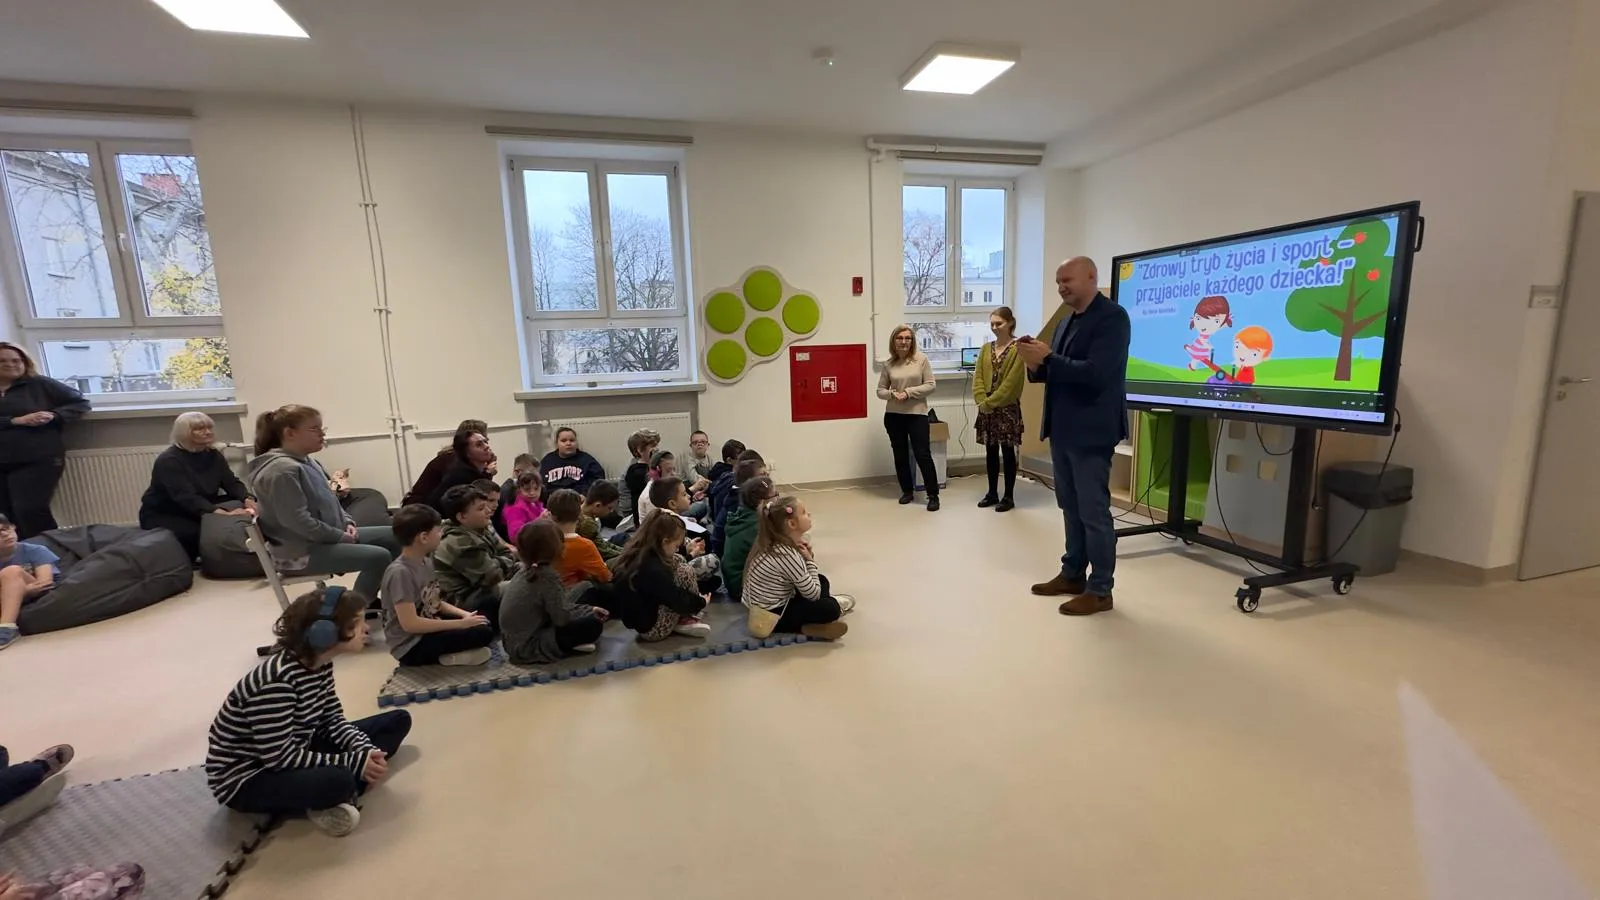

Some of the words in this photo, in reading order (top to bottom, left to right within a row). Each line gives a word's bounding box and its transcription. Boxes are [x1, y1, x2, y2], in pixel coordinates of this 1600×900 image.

[1138, 260, 1187, 280] "Zdrowy
[1191, 253, 1221, 276] tryb
[1225, 246, 1266, 272] życia
[1271, 242, 1277, 263] i
[1281, 235, 1331, 265] sport
[1136, 279, 1201, 306] przyjaciele
[1205, 274, 1265, 297] każdego
[1270, 258, 1354, 290] dziecka!"
[547, 466, 564, 483] NEW
[563, 465, 583, 481] YORK
